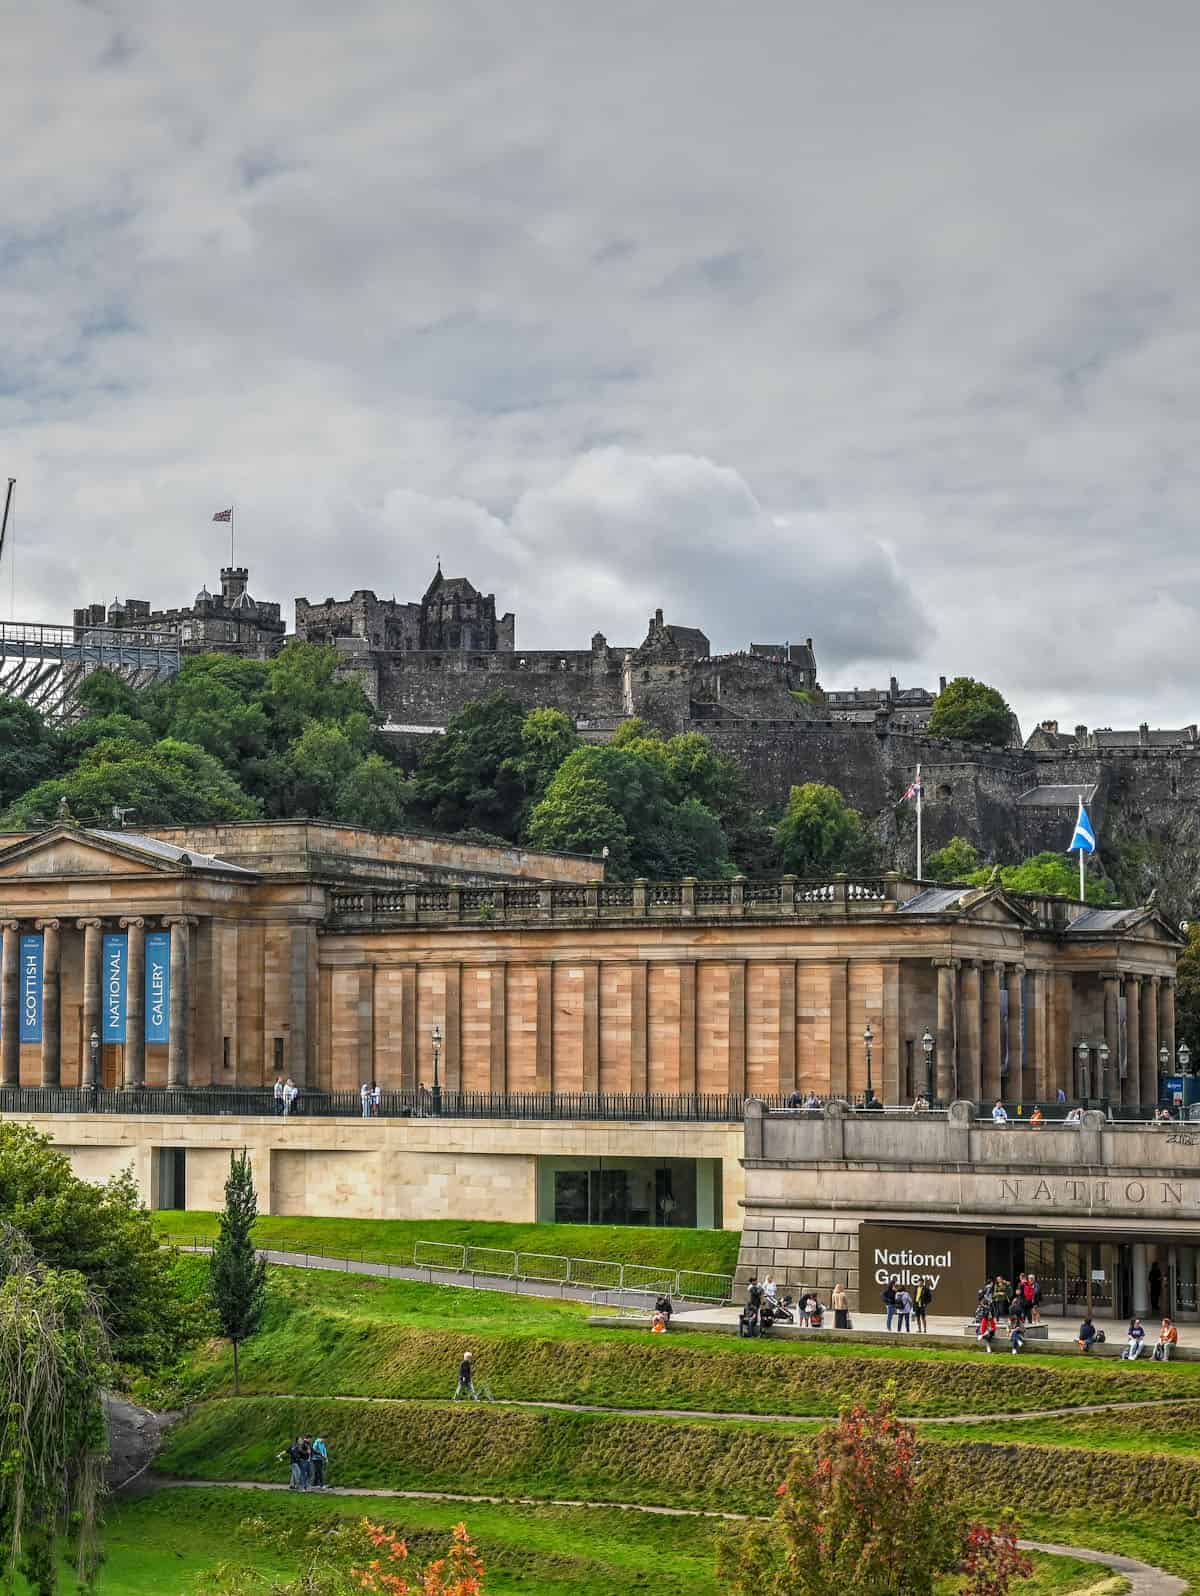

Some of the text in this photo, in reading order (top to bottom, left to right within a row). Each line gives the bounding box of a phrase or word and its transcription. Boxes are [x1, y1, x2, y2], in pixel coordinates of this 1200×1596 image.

[26, 956, 37, 1026] SCOTTISH
[110, 950, 121, 1028] NATIONAL
[152, 962, 163, 1026] GALLERY
[1000, 1179, 1200, 1204] NATION
[874, 1248, 952, 1268] National
[875, 1268, 940, 1290] Gallery
